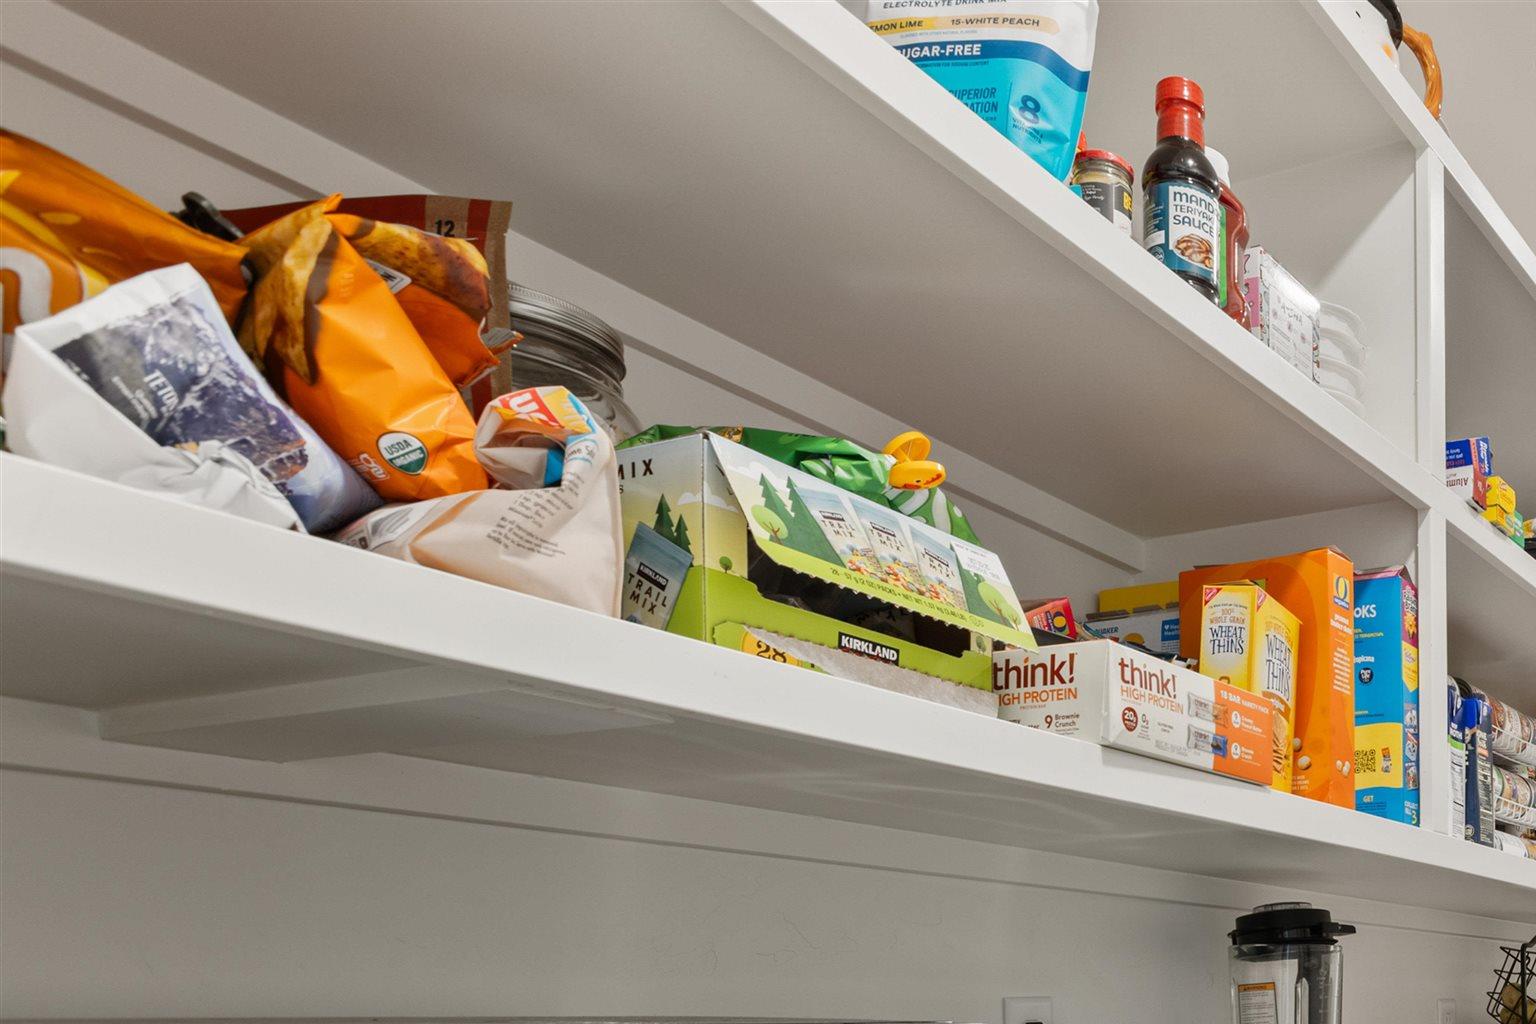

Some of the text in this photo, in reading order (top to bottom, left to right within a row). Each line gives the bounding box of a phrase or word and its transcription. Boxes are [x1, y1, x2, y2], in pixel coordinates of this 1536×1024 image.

[883, 1, 955, 10] ELECTROLYTE
[869, 20, 924, 33] EMON LIME
[951, 17, 1041, 27] 15-WHITE PEACH
[898, 43, 983, 60] UGAR-FREE
[965, 101, 999, 115] ATION
[1018, 94, 1042, 125] 8
[1173, 204, 1214, 223] TERIYAK
[434, 219, 456, 238] 12
[1173, 214, 1215, 239] SAUCE
[383, 439, 413, 456] USDA
[627, 572, 668, 608] TRAIL
[628, 591, 657, 615] MIX
[1097, 626, 1119, 635] UAKER
[1208, 625, 1246, 640] WHEAT
[840, 634, 898, 662] KIRKLAND
[1265, 633, 1293, 672] WHEAT
[992, 652, 1076, 692] think!
[1118, 657, 1177, 699] think!
[998, 687, 1078, 707] IGH PROTEIN
[1120, 685, 1184, 715] HIGH PROTEIN
[1044, 714, 1054, 729] 9
[1054, 712, 1080, 721] Brownie
[1054, 720, 1077, 729] Crunch
